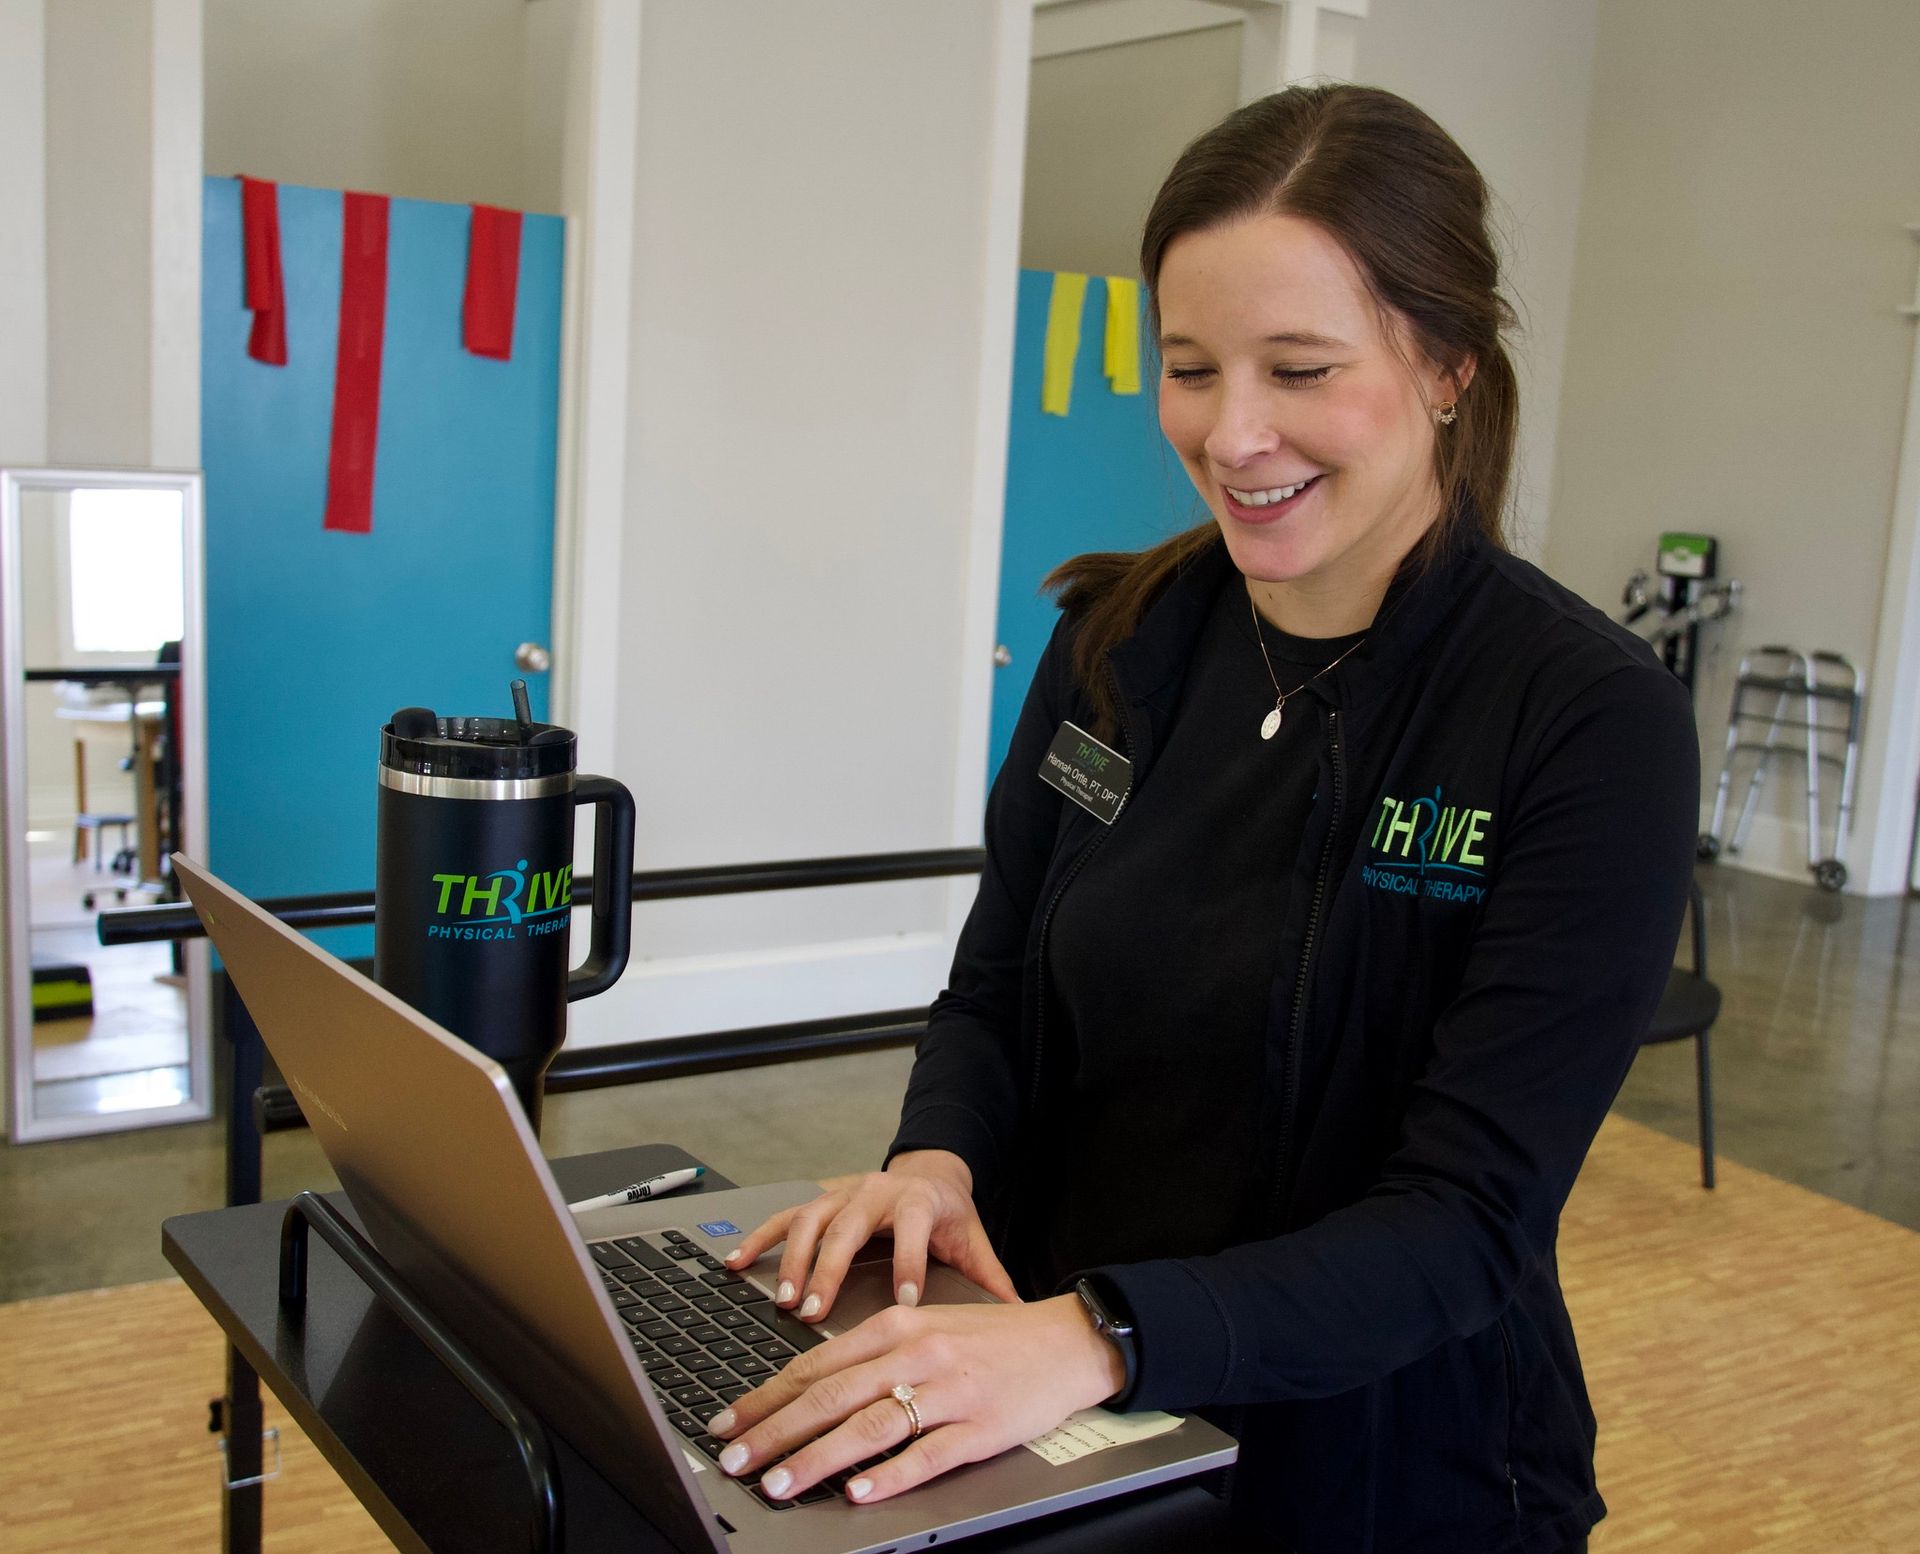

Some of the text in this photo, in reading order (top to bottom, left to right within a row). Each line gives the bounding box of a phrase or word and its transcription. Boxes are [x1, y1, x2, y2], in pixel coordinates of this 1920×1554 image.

[1047, 752, 1072, 775] Hannah
[1089, 780, 1101, 797] PT,
[1101, 788, 1119, 805] DPT
[1076, 742, 1110, 772] THRIVE
[1371, 787, 1492, 868] THRIVE
[432, 859, 572, 923] THRIVE
[1362, 865, 1487, 905] PHYSICAL THERAPY
[428, 914, 571, 941] PHYSICAL THERAP
